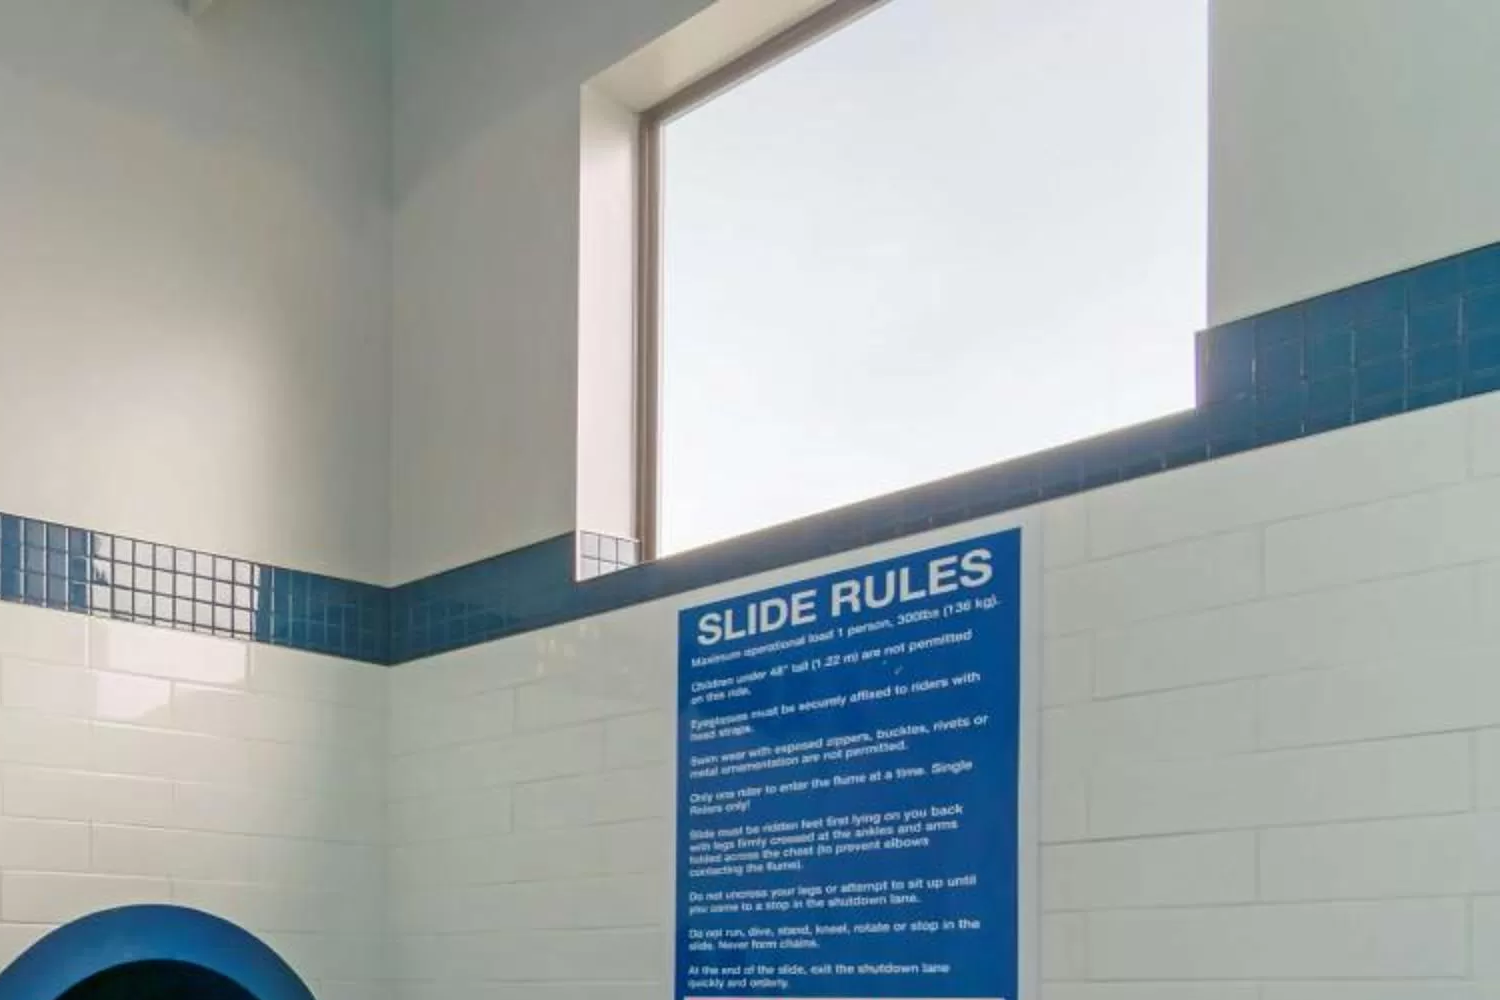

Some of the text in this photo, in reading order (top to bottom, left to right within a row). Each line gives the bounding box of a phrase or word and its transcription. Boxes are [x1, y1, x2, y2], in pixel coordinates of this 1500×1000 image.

[697, 548, 993, 646] SLIDE RULES
[861, 649, 880, 659] are
[884, 642, 904, 655] not
[908, 629, 971, 652] permitted
[751, 706, 777, 719] must
[849, 686, 891, 702] affixed
[911, 679, 948, 692] riders
[951, 671, 980, 685] with
[747, 746, 772, 758] with
[773, 738, 822, 754] exposed
[876, 725, 929, 739] buckles,
[933, 717, 970, 731] rivets
[801, 740, 907, 763] are not permitted.
[689, 792, 714, 803] Only
[778, 781, 809, 792] enter
[809, 778, 830, 788] the
[832, 775, 866, 786] flume
[931, 760, 972, 774] Single
[801, 818, 823, 829] feet
[826, 815, 848, 826] first
[851, 813, 881, 825] lying
[904, 809, 926, 821] you
[930, 803, 962, 816] back
[689, 842, 710, 852] with
[737, 837, 767, 848] firmly
[832, 829, 851, 839] the
[854, 826, 894, 837] ankles
[897, 822, 921, 833] and
[925, 821, 957, 831] arms
[761, 849, 780, 858] the
[782, 845, 813, 856] chest
[835, 839, 880, 854] prevent
[883, 837, 929, 848] elbows
[745, 863, 764, 872] the
[705, 891, 722, 900] not
[770, 888, 795, 898] your
[840, 880, 887, 892] attempt
[908, 878, 922, 888] sit
[947, 875, 976, 886] until
[765, 900, 789, 910] stop
[805, 898, 824, 907] the
[827, 896, 886, 906] shutdown
[705, 928, 722, 937] not
[747, 927, 773, 936] dive,
[815, 923, 849, 933] kneel,
[853, 922, 890, 932] rotate
[910, 920, 938, 931] stop
[958, 918, 979, 928] the
[751, 940, 776, 948] form
[702, 966, 718, 975] the
[721, 966, 740, 974] end
[757, 965, 774, 974] the
[778, 965, 807, 974] slide,
[810, 964, 832, 973] exit
[835, 964, 854, 973] the
[857, 963, 918, 973] shutdown
[921, 963, 949, 972] lane
[688, 978, 723, 989] quickly
[727, 978, 746, 987] and
